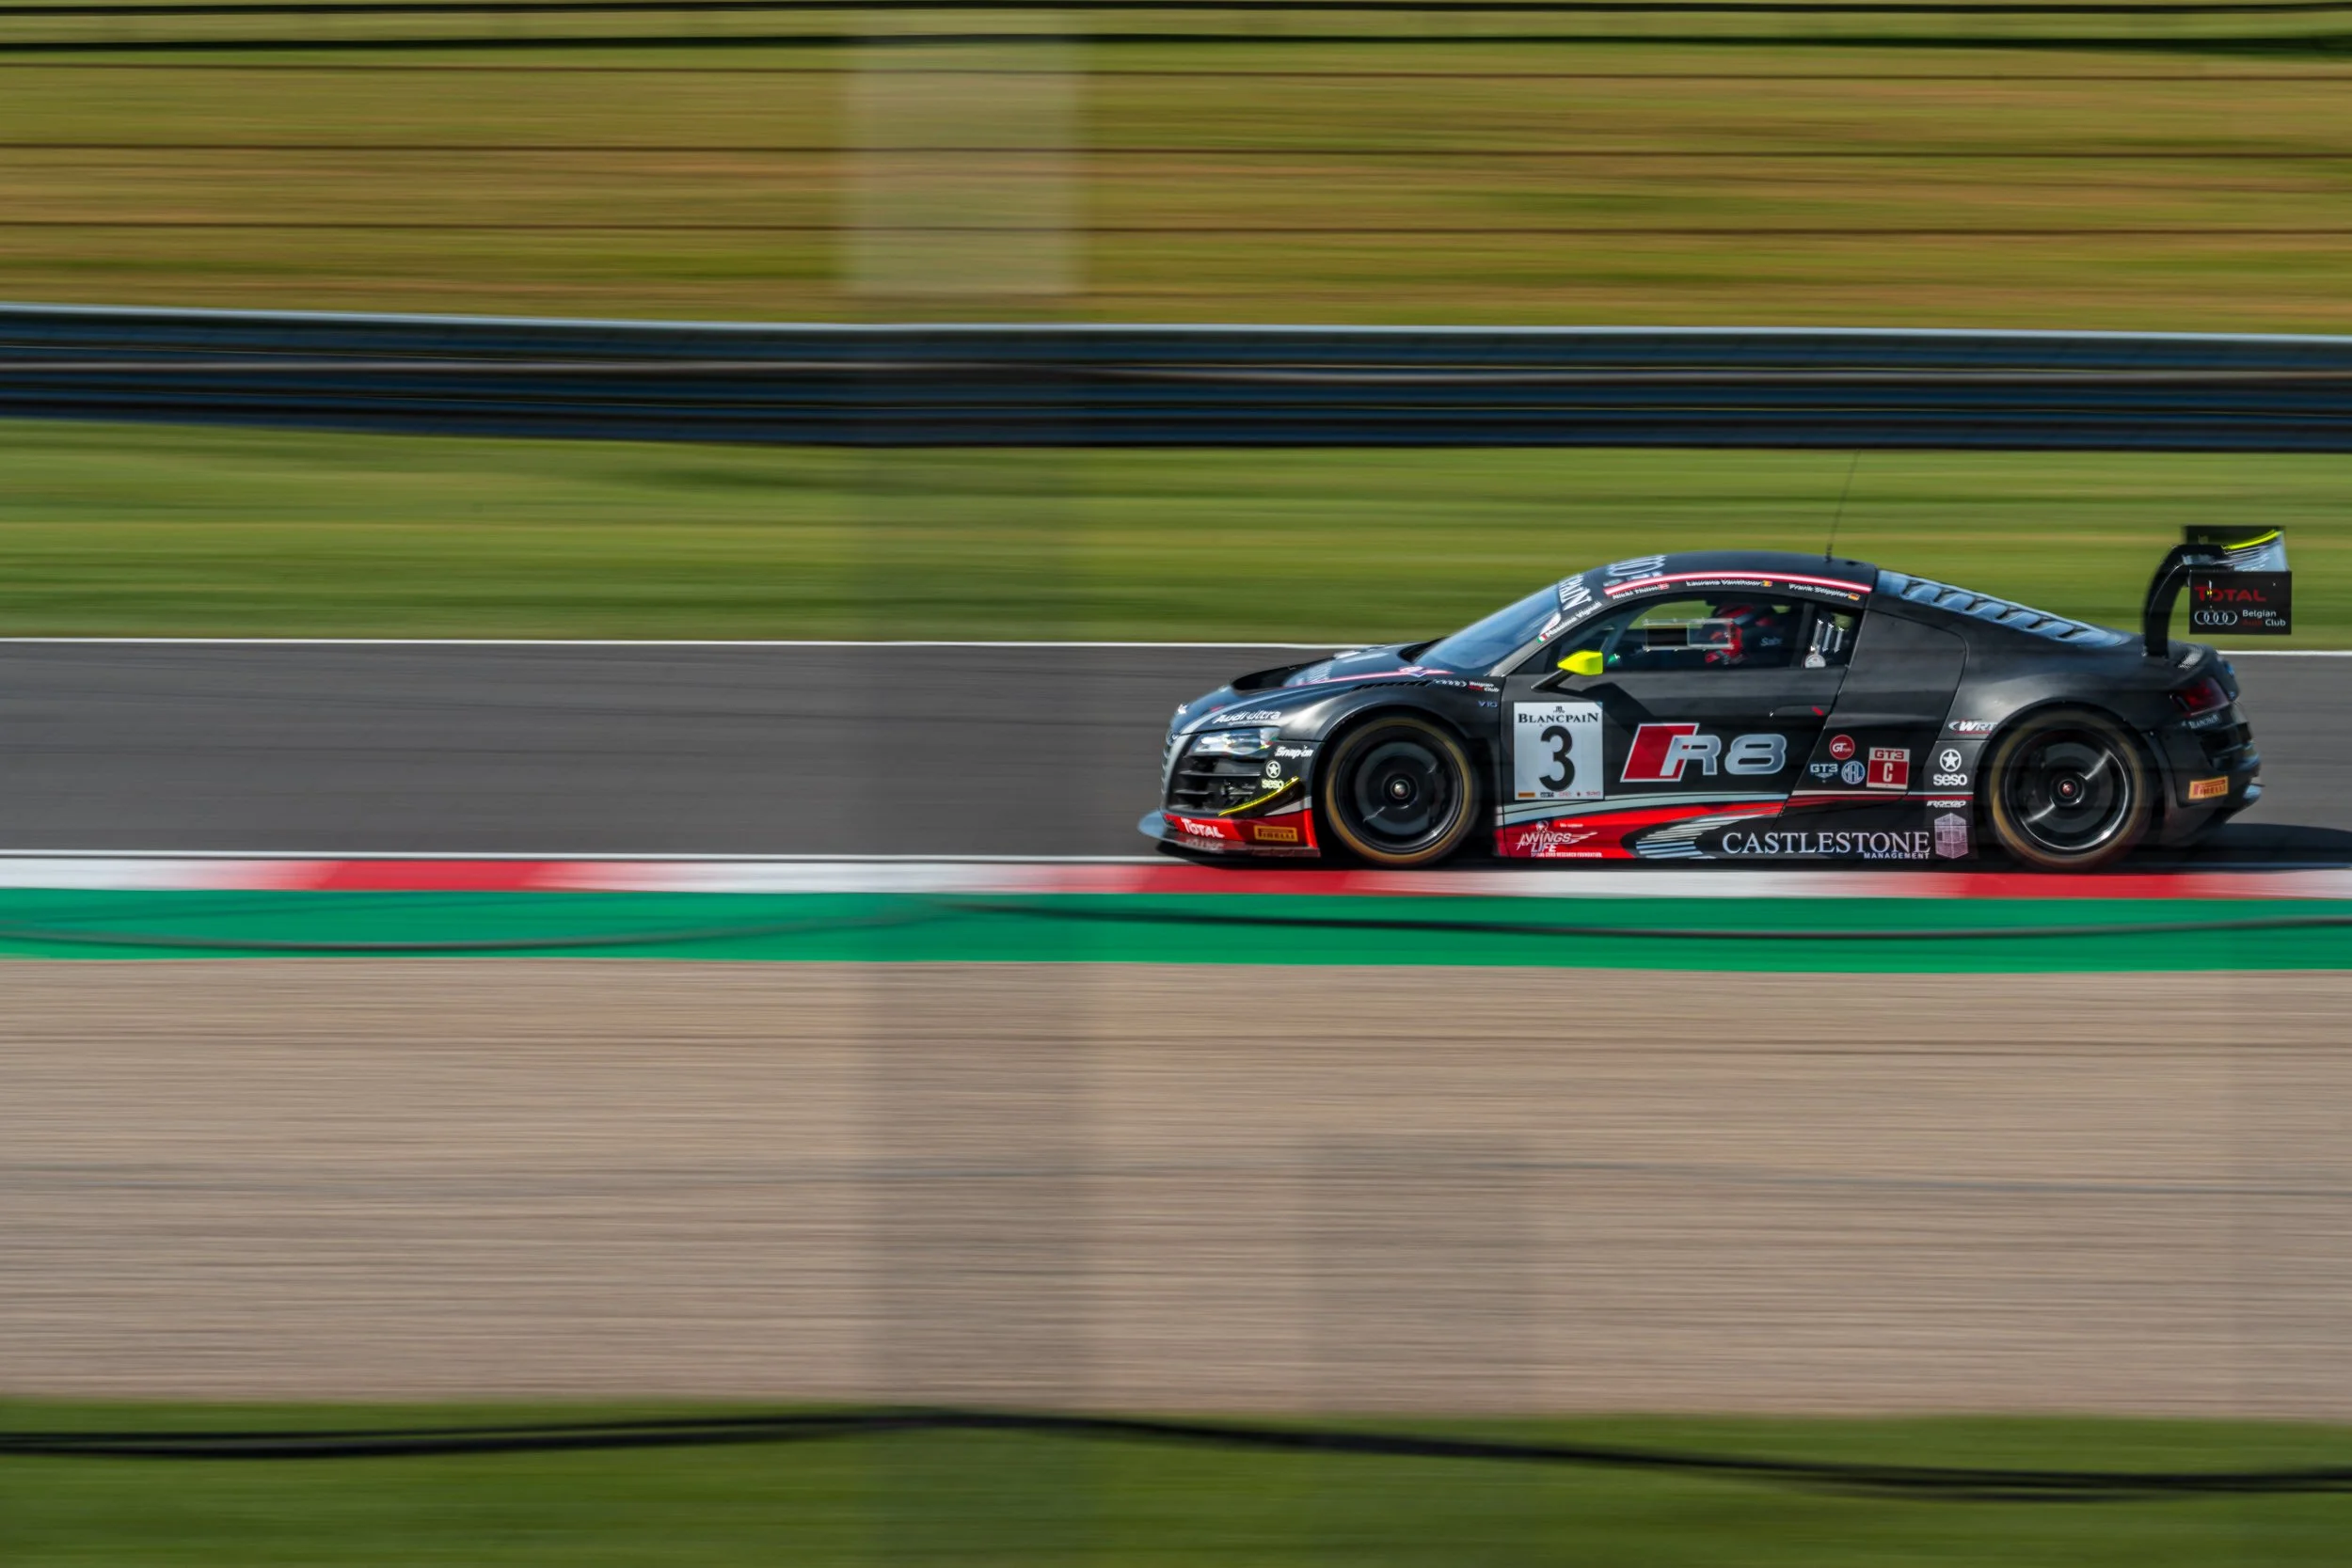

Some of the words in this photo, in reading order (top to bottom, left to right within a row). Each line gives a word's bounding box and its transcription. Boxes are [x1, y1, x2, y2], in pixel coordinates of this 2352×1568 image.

[2194, 585, 2266, 602] TOTAL
[2243, 610, 2277, 619] Belgian
[2265, 619, 2286, 627] Club
[1518, 713, 1599, 723] BLANCPAIN
[1539, 725, 1576, 792] 3
[1660, 734, 1788, 776] R8
[1875, 750, 1904, 760] GT3
[1810, 764, 1838, 772] GT3
[1883, 762, 1894, 783] C
[1933, 773, 1968, 786] seso
[1181, 817, 1225, 838] TOTAL
[1526, 832, 1572, 843] WINGS
[1722, 832, 1931, 854] CASTLESTONE
[1531, 843, 1558, 853] LIFE
